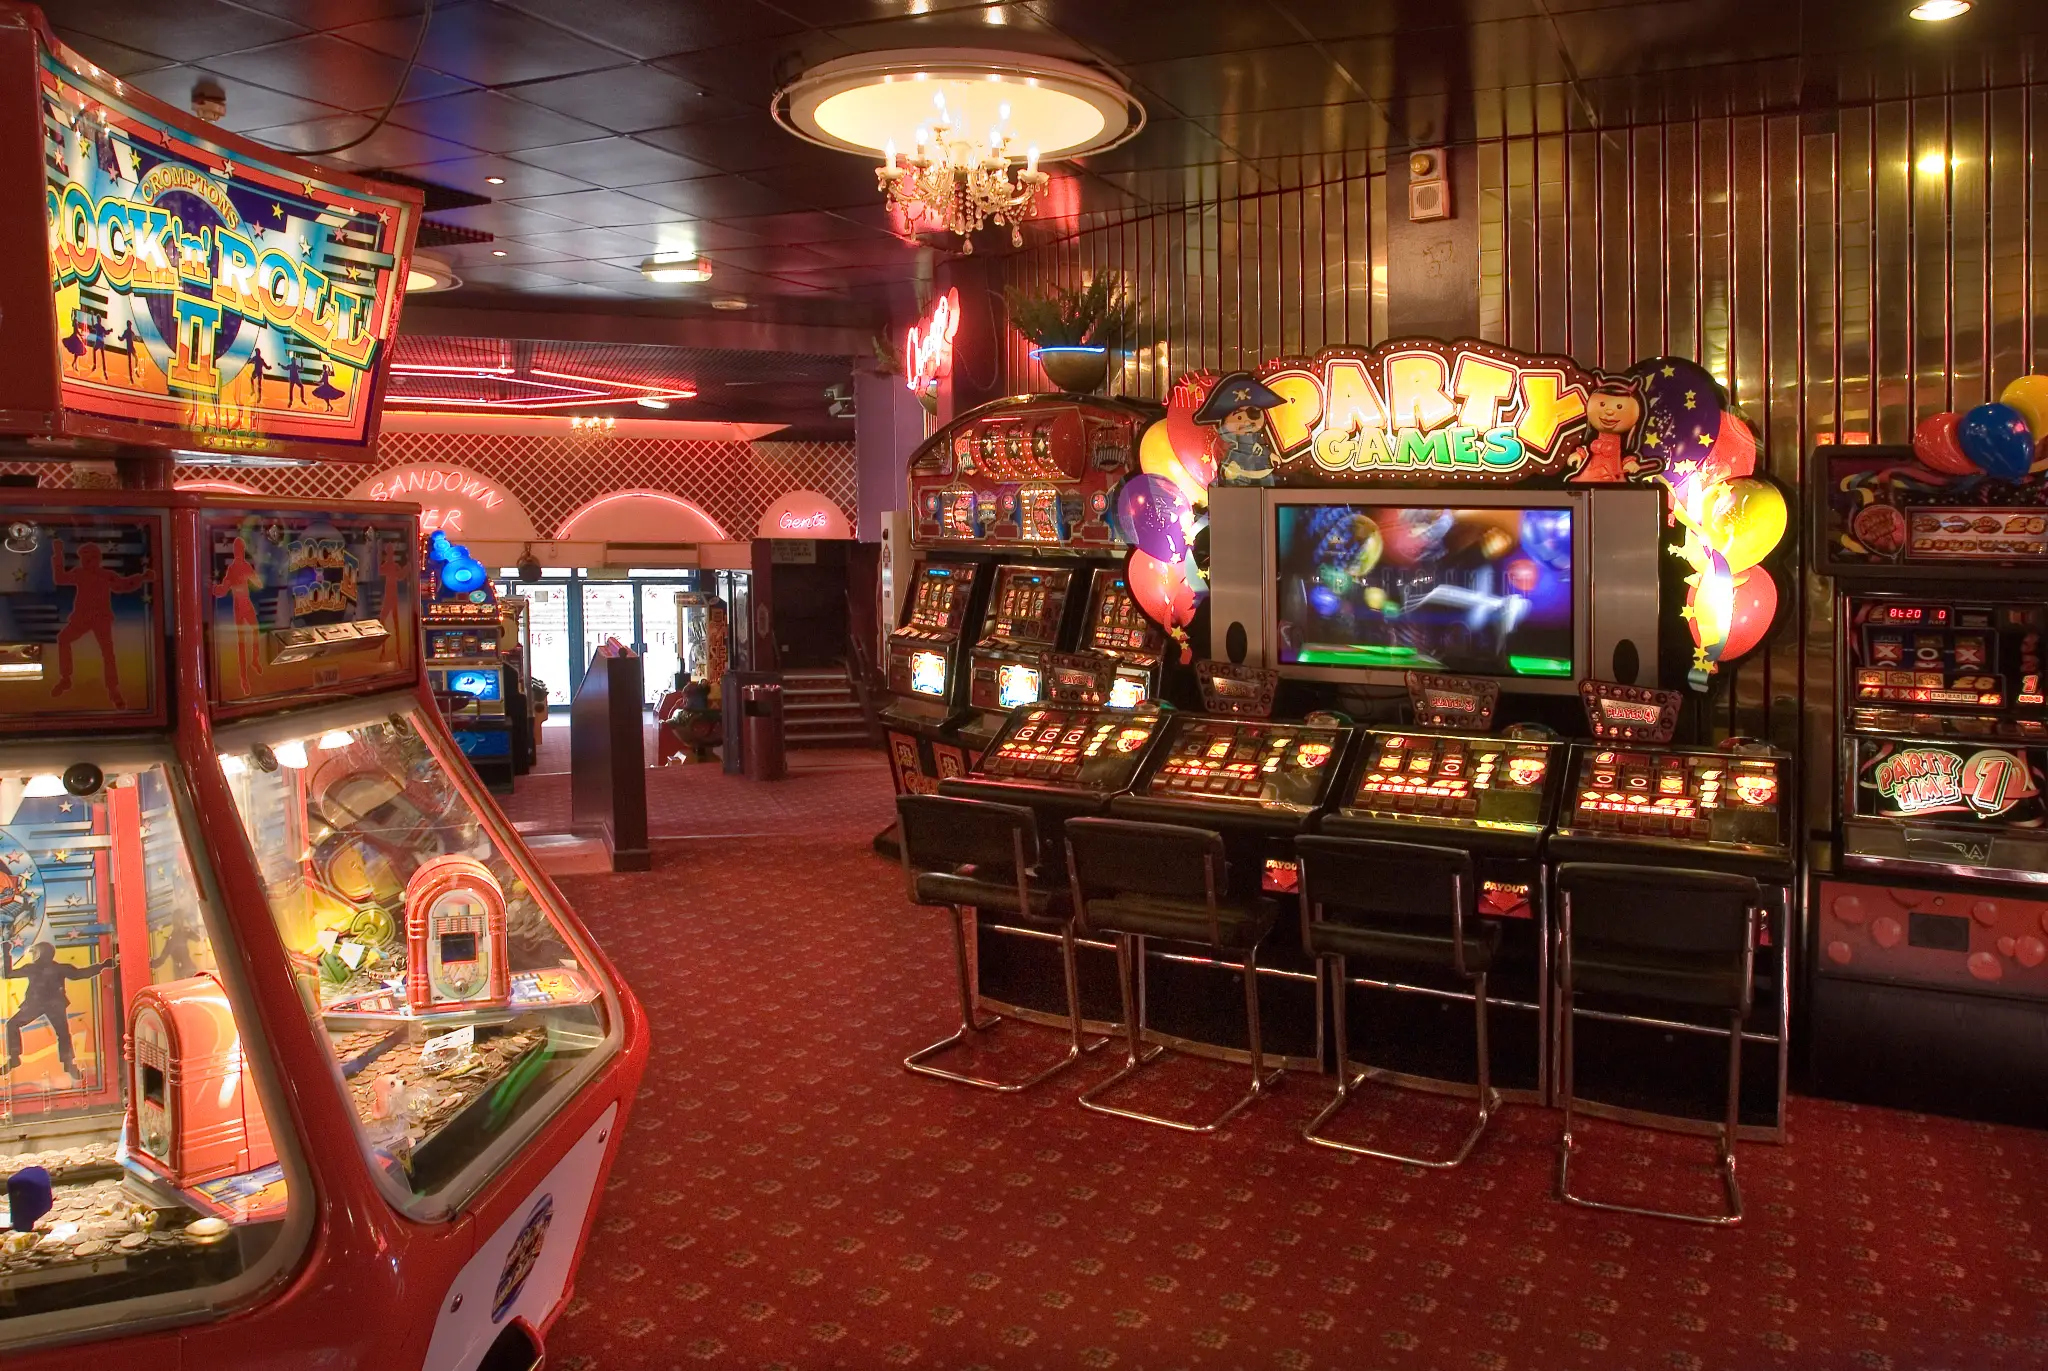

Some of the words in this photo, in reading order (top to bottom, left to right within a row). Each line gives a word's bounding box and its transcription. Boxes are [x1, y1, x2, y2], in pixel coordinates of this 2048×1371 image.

[142, 166, 239, 231] CROMPTONS
[47, 182, 183, 296] ROCK
[213, 226, 381, 370] ROLL
[1263, 351, 1588, 453] PARTY
[1315, 428, 1526, 466] GAMES
[370, 470, 504, 509] SANDOWN
[419, 509, 463, 532] ER
[779, 511, 826, 529] Gents
[1606, 707, 1643, 720] PLAYER
[1643, 707, 1656, 725] 4
[1876, 749, 1962, 796] PARTY
[1896, 775, 1961, 811] TIME
[1972, 757, 2012, 810] 1
[1266, 860, 1297, 870] PAYOU
[1484, 881, 1526, 894] PAYOUT
